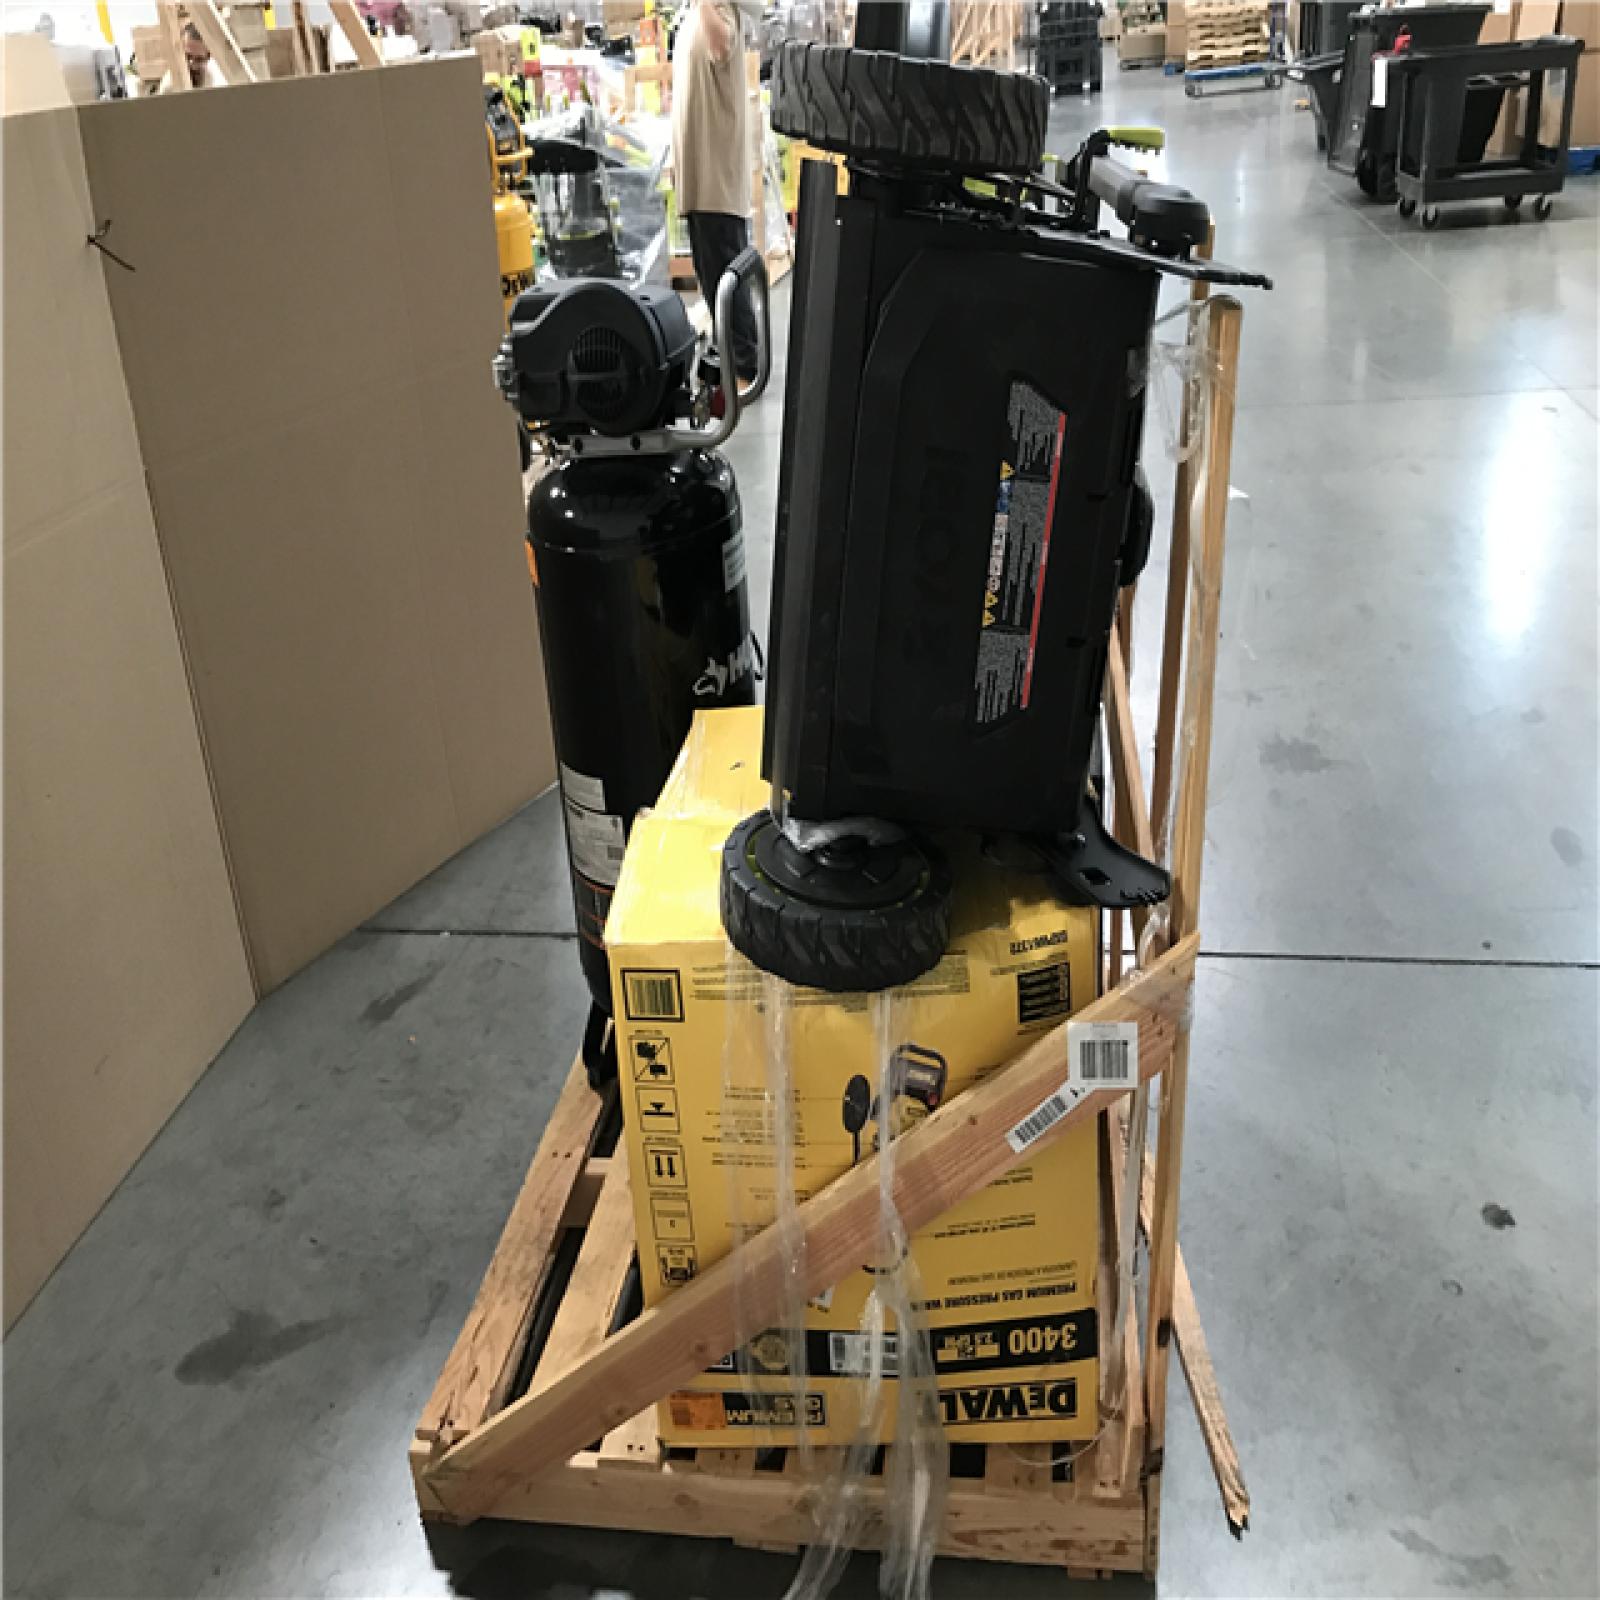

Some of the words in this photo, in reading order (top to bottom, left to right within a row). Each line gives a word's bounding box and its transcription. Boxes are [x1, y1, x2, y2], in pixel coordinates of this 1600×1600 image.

[1002, 1290, 1024, 1302] GAS
[1026, 1283, 1077, 1299] PREMIUM
[944, 1292, 1000, 1308] PRESSURE
[1009, 1322, 1078, 1355] 3400
